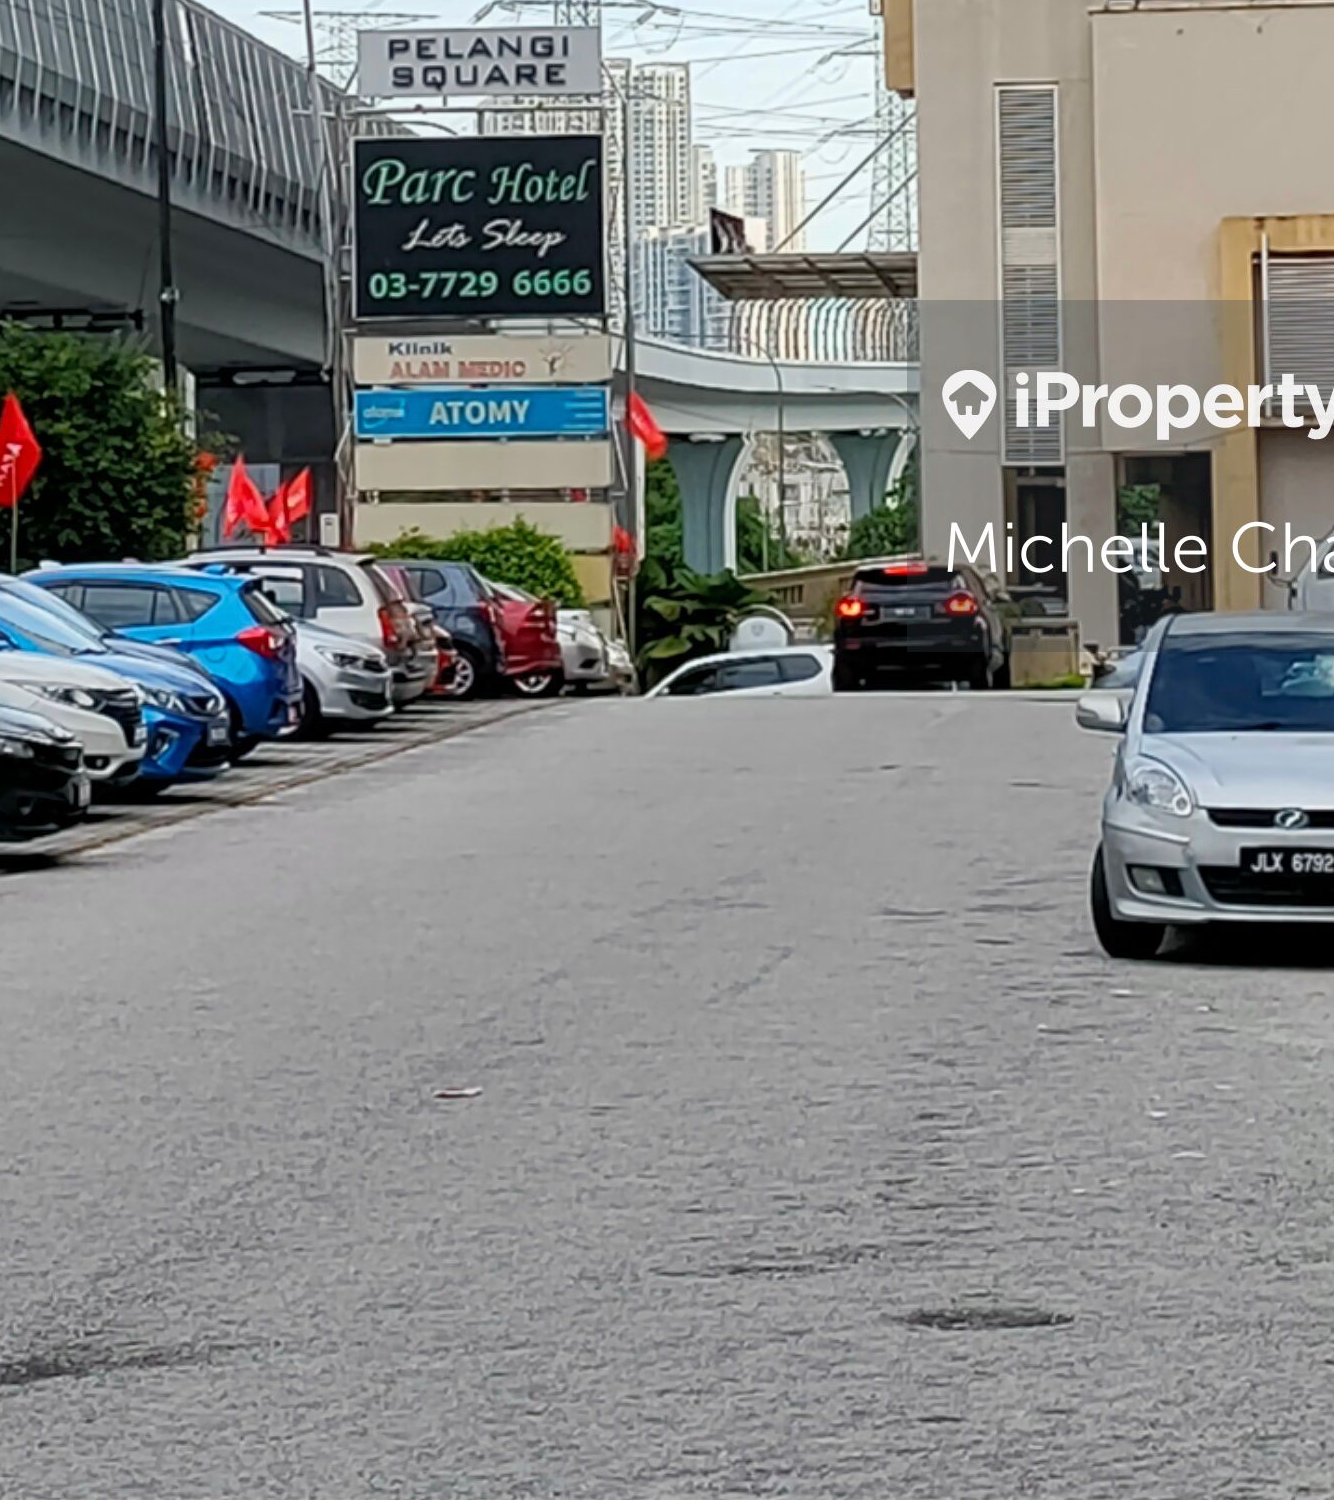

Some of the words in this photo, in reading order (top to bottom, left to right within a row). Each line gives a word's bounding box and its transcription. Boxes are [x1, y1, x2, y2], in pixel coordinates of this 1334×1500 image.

[388, 34, 570, 61] PELANGI
[391, 63, 567, 92] SQUARE
[362, 158, 477, 205] Parc
[486, 158, 597, 205] Hotel
[401, 218, 473, 251] Lets
[480, 218, 567, 258] Sleep
[368, 270, 499, 300] 03-7729
[512, 269, 593, 297] 6666
[388, 342, 454, 356] Klinik
[389, 361, 450, 379] ALAM
[457, 360, 528, 379] MEDIC
[429, 399, 531, 425] ATOMY
[1249, 853, 1284, 873] JLX
